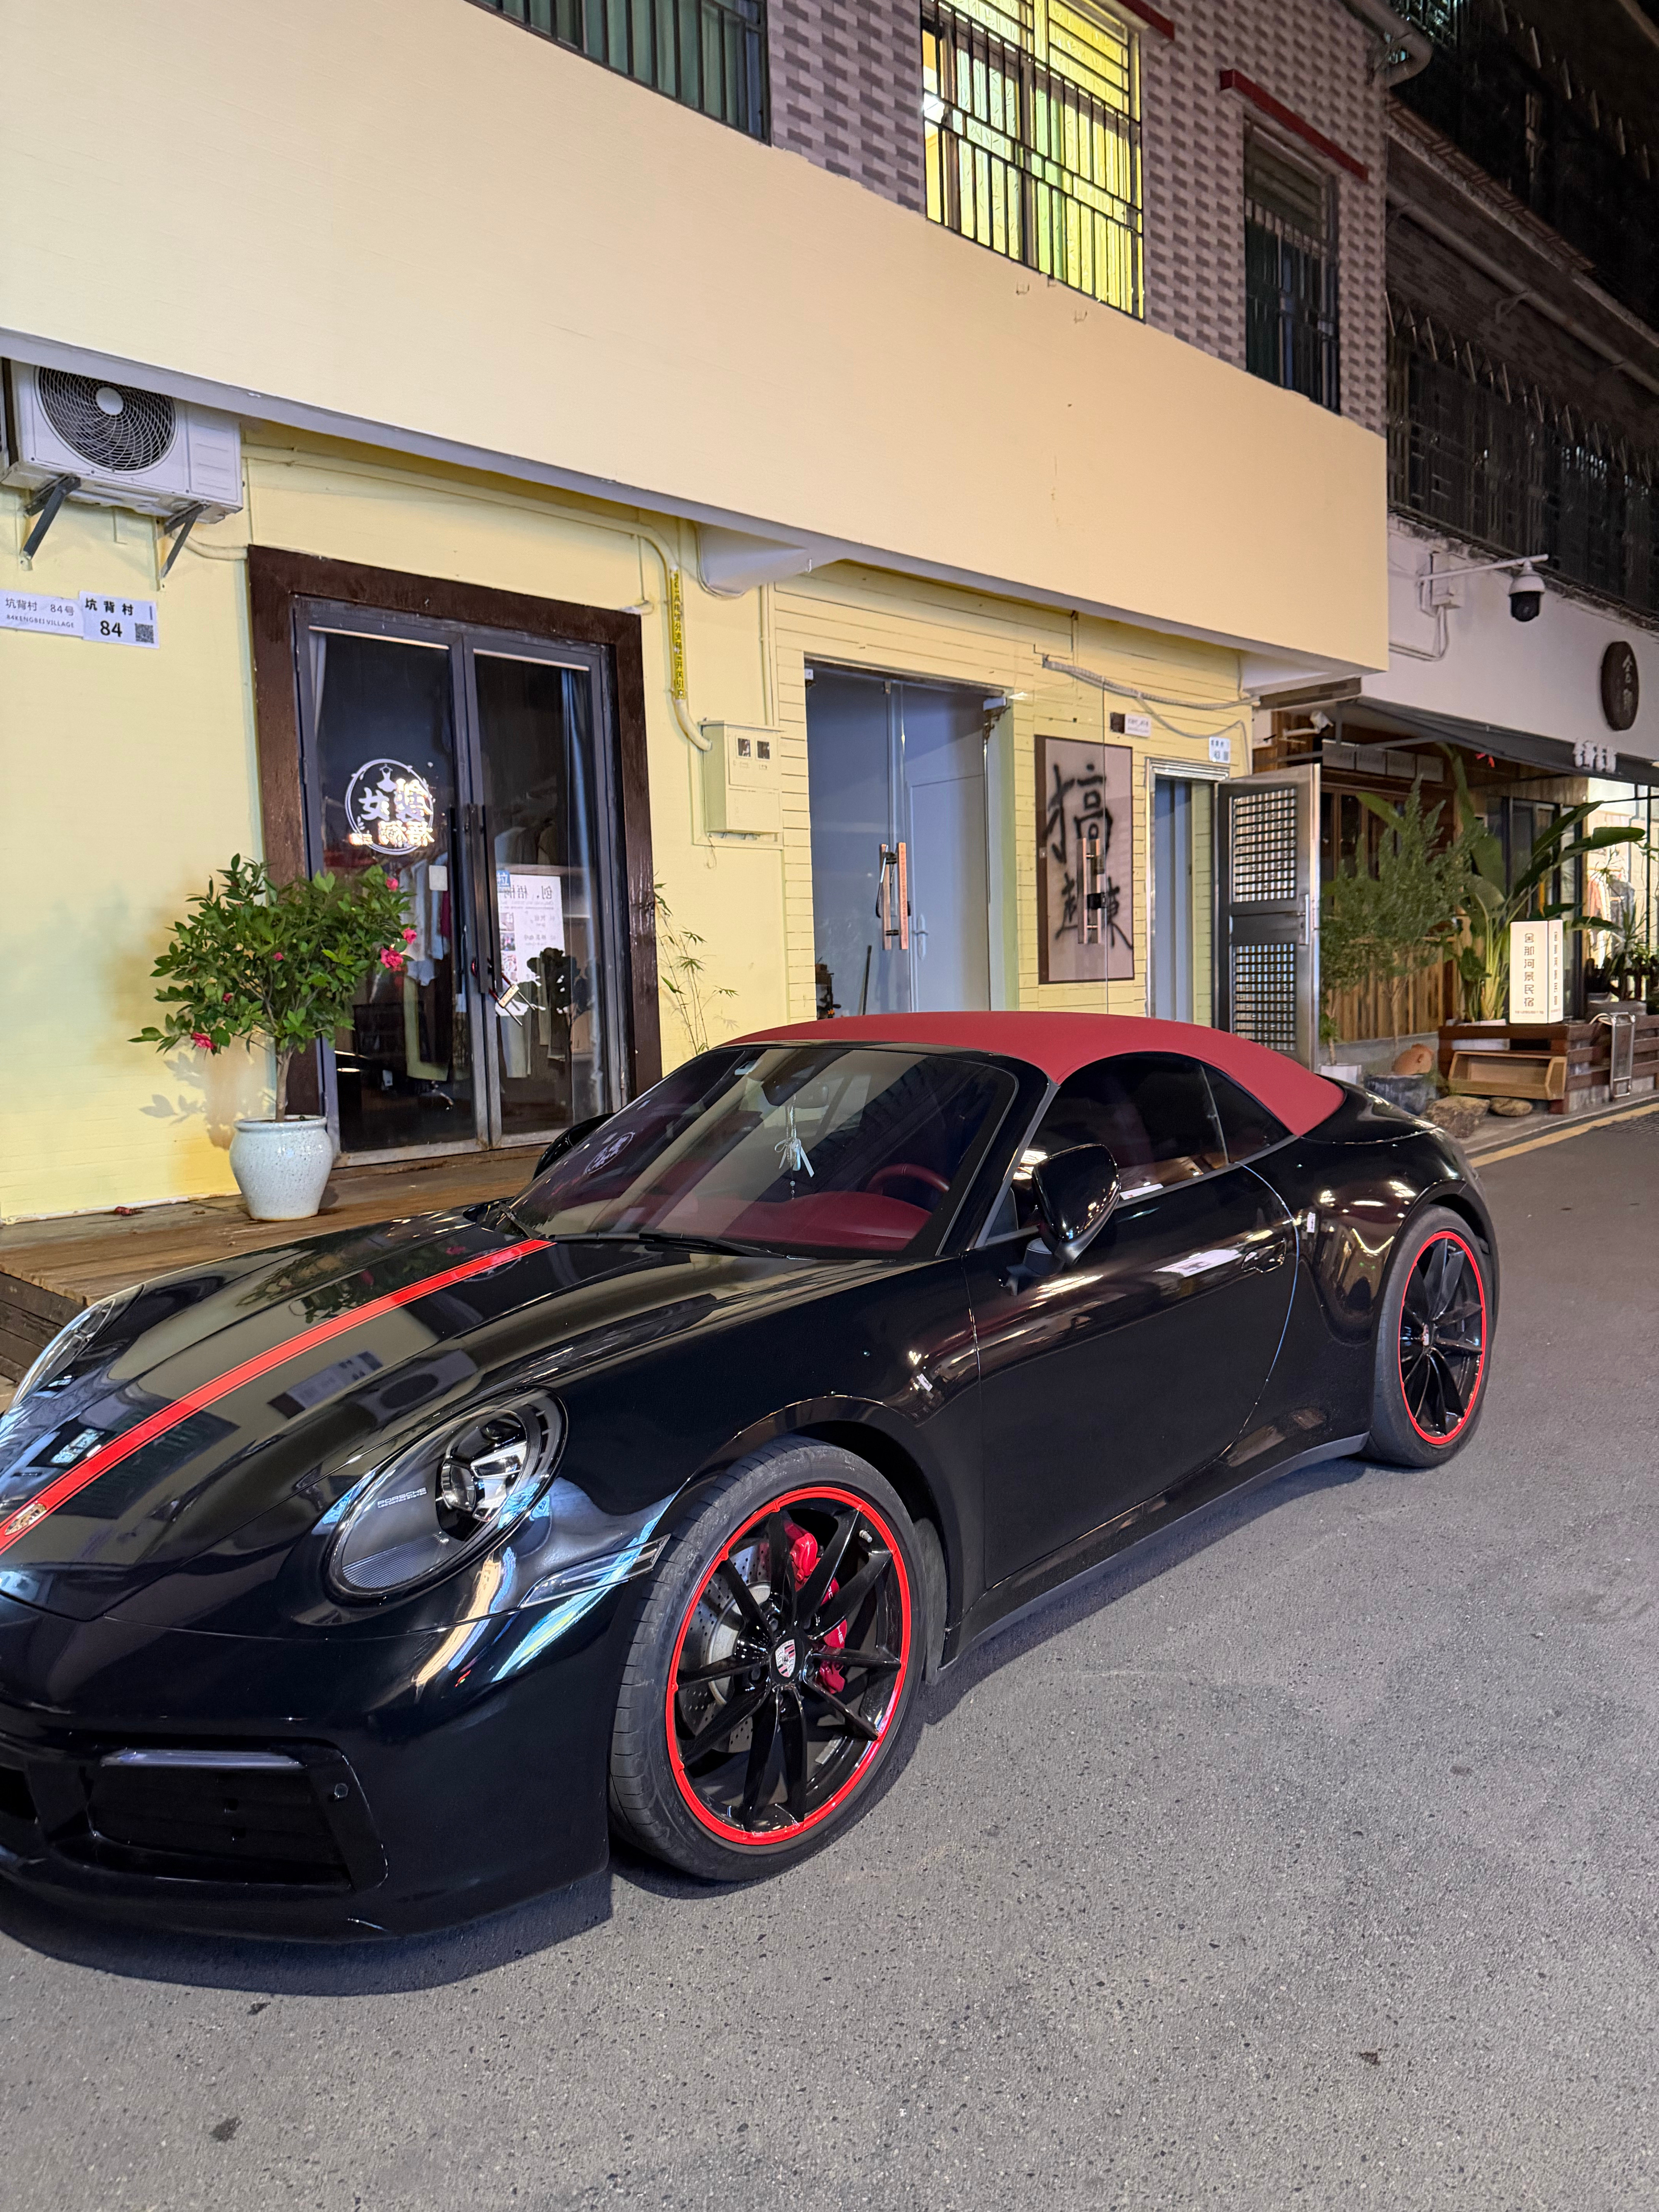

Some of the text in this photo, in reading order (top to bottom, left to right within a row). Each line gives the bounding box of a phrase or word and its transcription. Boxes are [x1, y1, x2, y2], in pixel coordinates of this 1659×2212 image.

[5, 598, 74, 616] 坑背村 84号
[85, 598, 133, 616] 坑背村
[46, 620, 74, 628] VILLAGE
[100, 620, 122, 637] 84
[378, 1487, 426, 1506] PORSCHE
